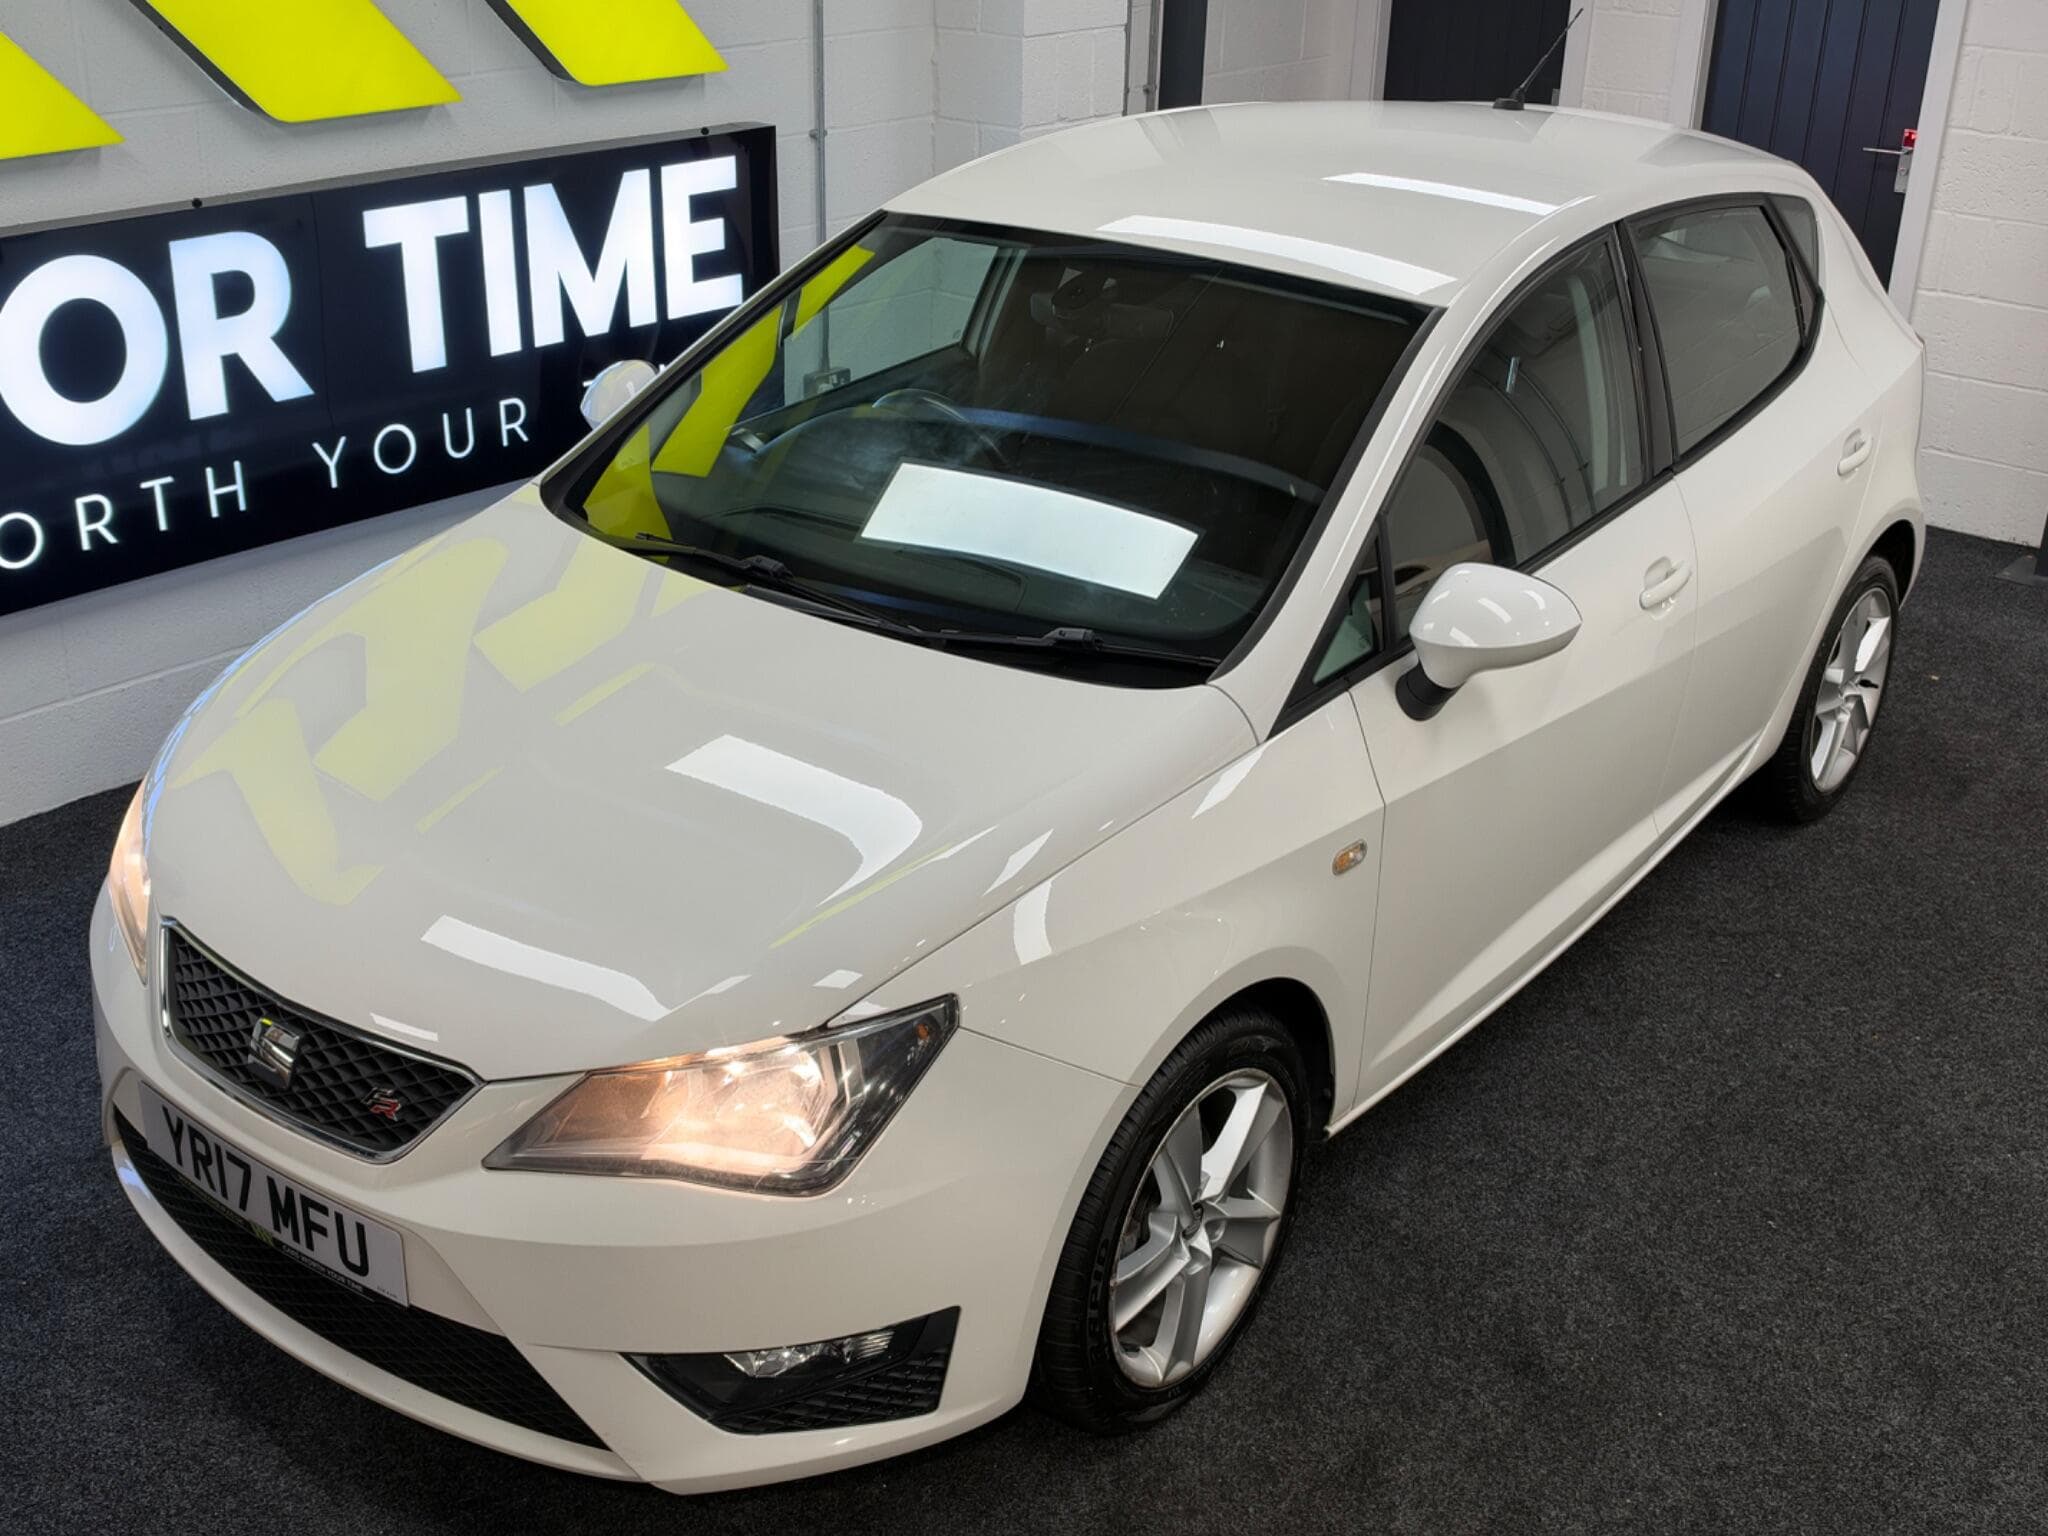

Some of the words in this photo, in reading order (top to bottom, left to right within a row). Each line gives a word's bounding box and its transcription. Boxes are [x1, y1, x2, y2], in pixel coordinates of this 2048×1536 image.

[0, 231, 314, 446] OR
[363, 155, 744, 373] TIME
[0, 460, 247, 569] ORTH
[312, 397, 530, 489] YOUR
[162, 1105, 252, 1211] YR17
[266, 1175, 369, 1277] MFU
